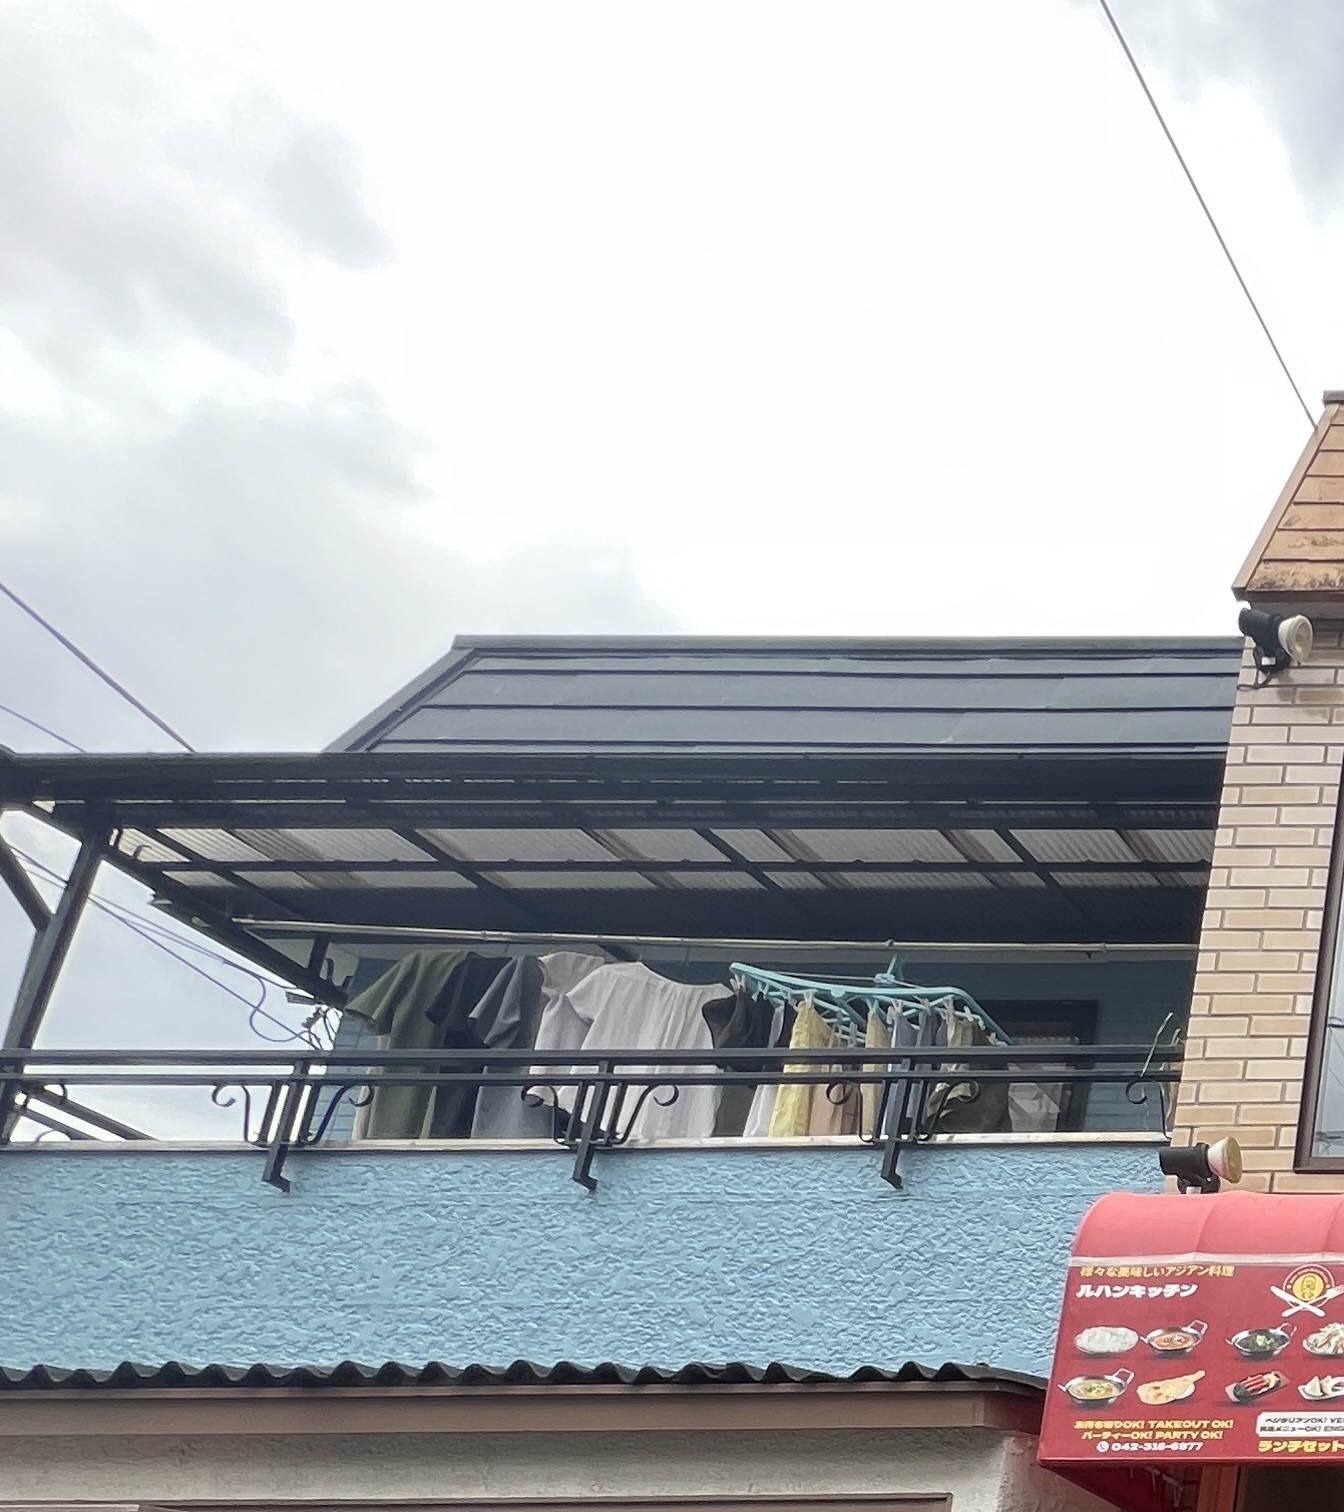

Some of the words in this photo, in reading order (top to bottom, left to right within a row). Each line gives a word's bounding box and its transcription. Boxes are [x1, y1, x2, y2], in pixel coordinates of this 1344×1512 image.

[1076, 1284, 1198, 1298] ルハンキッチン
[1148, 1420, 1210, 1429] TAKEOUT
[1212, 1419, 1234, 1429] OK!
[1155, 1431, 1199, 1439] PARTY
[1200, 1431, 1223, 1439] OK!
